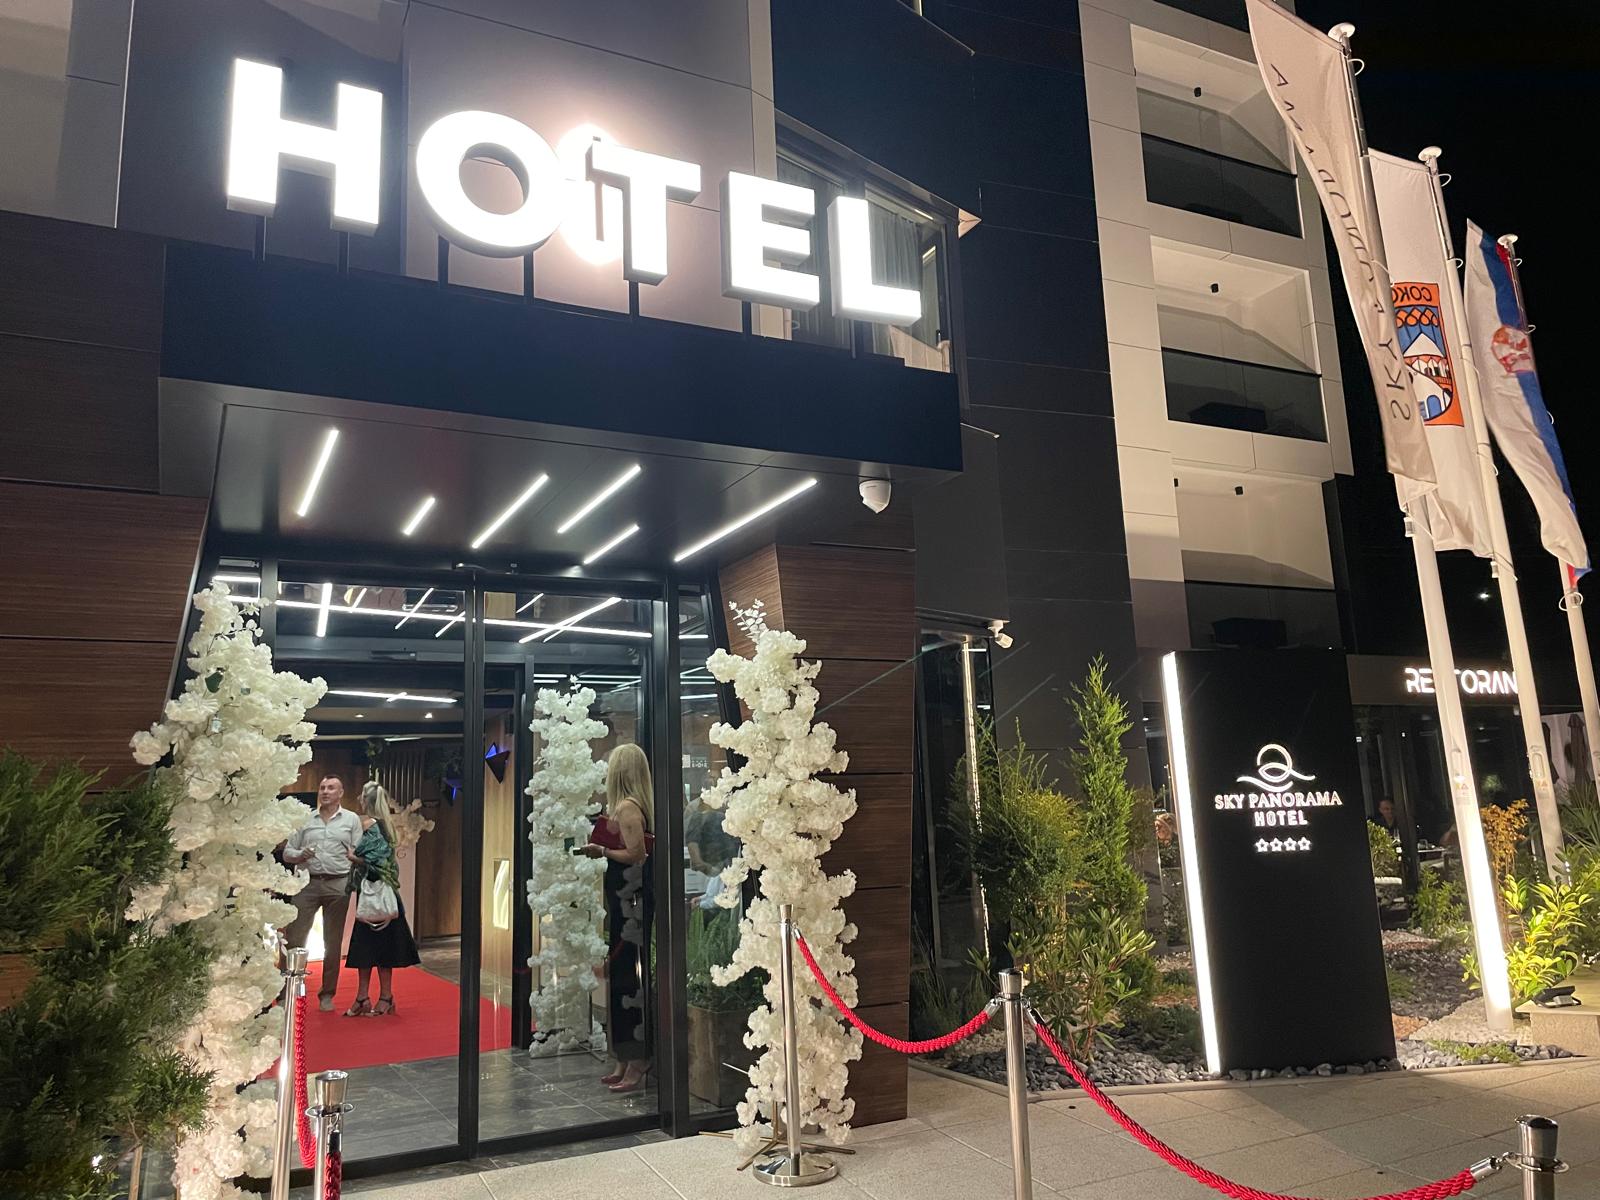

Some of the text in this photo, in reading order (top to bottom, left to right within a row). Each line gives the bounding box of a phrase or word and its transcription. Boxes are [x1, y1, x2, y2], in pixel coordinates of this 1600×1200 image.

[226, 57, 923, 326] HOTEL
[1405, 667, 1518, 694] REORAN
[1214, 791, 1342, 809] SKY PANORAMA
[1254, 810, 1308, 827] HOTEL
